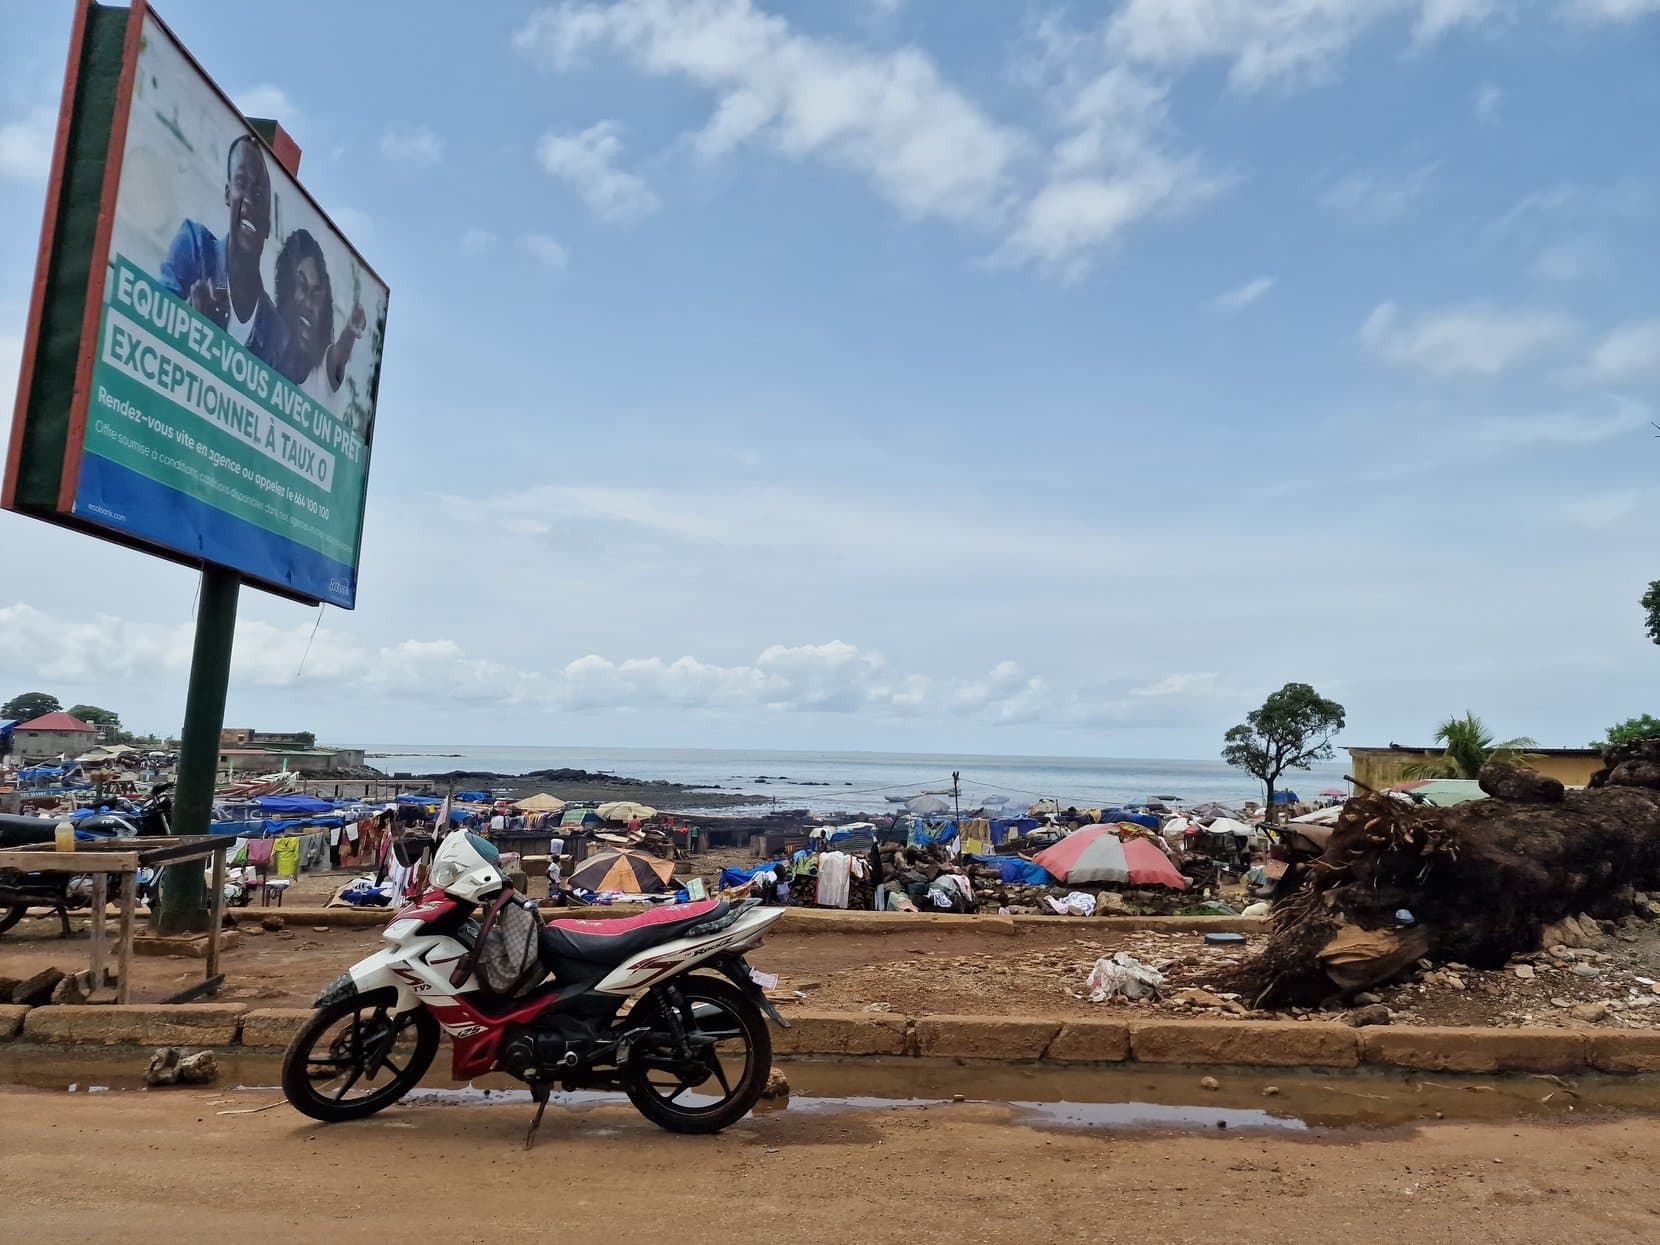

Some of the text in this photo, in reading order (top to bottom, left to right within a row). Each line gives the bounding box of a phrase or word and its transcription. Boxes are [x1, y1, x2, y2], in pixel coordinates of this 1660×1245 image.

[118, 266, 361, 463] EQUIPEZ-VOUS AVEC UN PRÊT
[95, 419, 117, 440] Offre
[110, 324, 261, 444] EXCEPTIONNEL
[265, 417, 275, 453] À
[281, 432, 316, 477] TAUX
[98, 385, 174, 439] Rendez-vous
[176, 430, 195, 449] vite
[195, 442, 208, 457] en
[208, 448, 241, 474] agence
[242, 467, 254, 481] ou
[255, 474, 285, 497] appelez
[286, 487, 294, 501] le
[413, 983, 432, 992] TVS
[457, 1026, 481, 1038] 125
